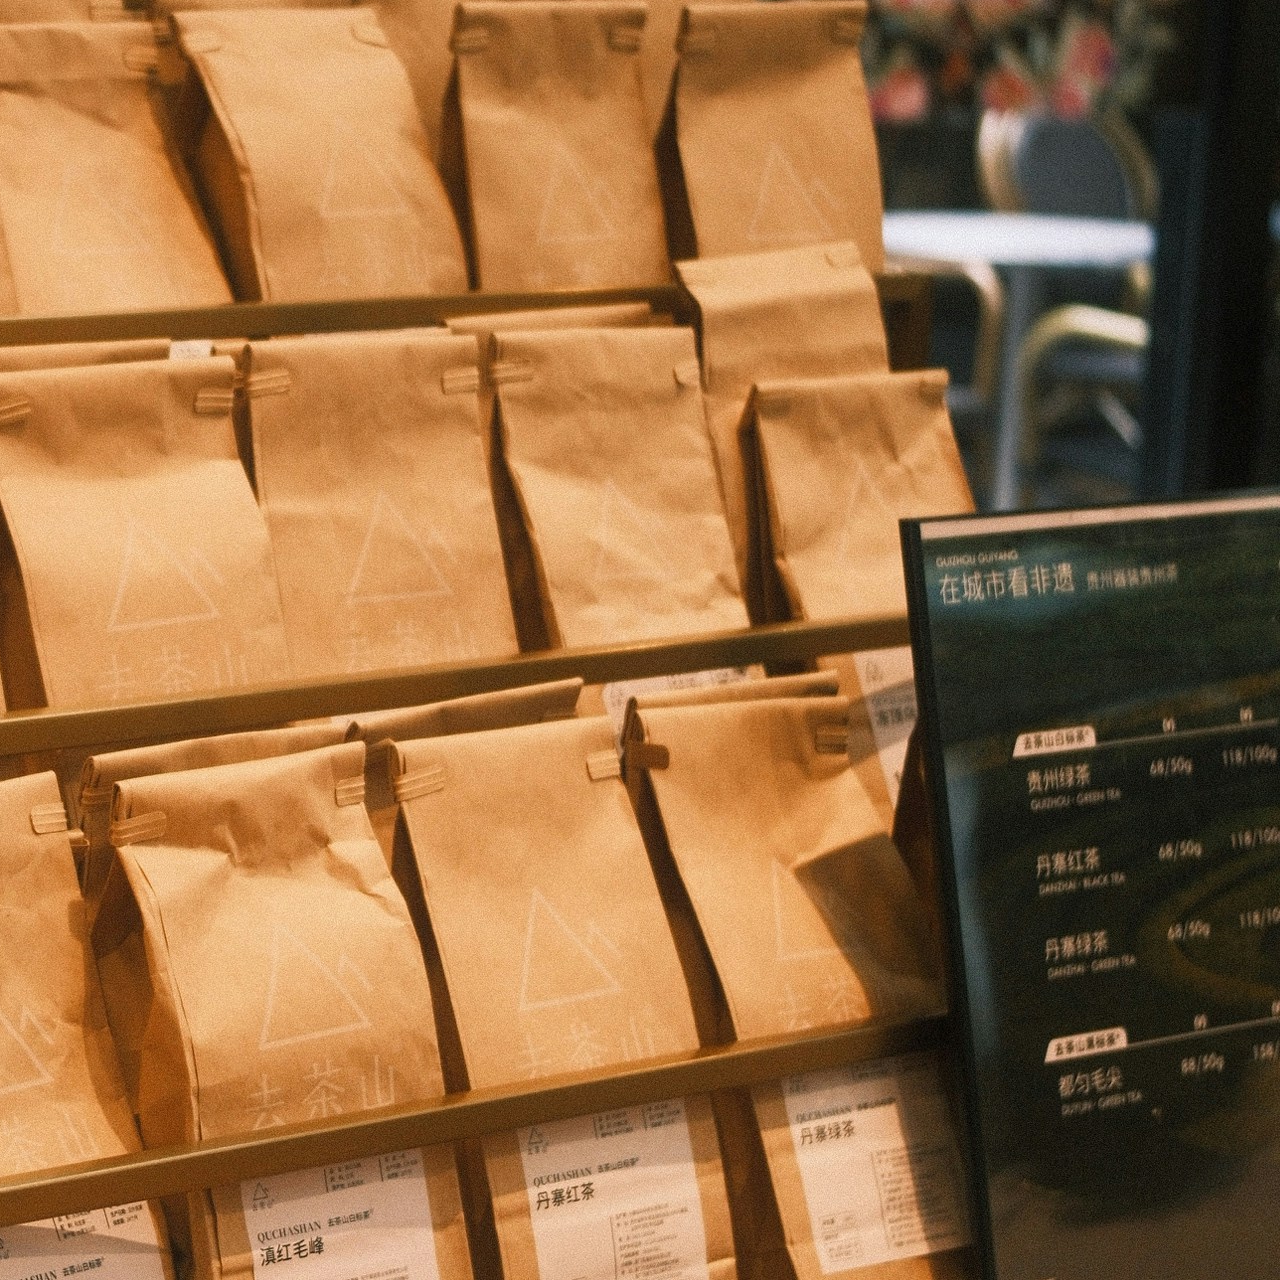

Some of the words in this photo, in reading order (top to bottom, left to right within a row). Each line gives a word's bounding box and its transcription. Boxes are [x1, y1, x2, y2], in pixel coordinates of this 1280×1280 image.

[939, 562, 1074, 605] 在城市看非遗
[1027, 762, 1091, 793] 贵州绿茶
[1036, 846, 1101, 879] 丹寨红茶
[1045, 929, 1108, 963] 丹寨绿茶
[248, 1055, 400, 1128] 去茶山
[1059, 1065, 1122, 1098] 都匀毛尖
[533, 1167, 593, 1188] QUCHASHAN
[536, 1182, 595, 1211] 丹寨红茶
[257, 1219, 322, 1244] QUCHASHAN
[327, 1209, 371, 1228] 去茶山白标茶
[62, 1258, 103, 1278] 去茶山白标茶
[260, 1236, 325, 1267] 滇红毛峰
